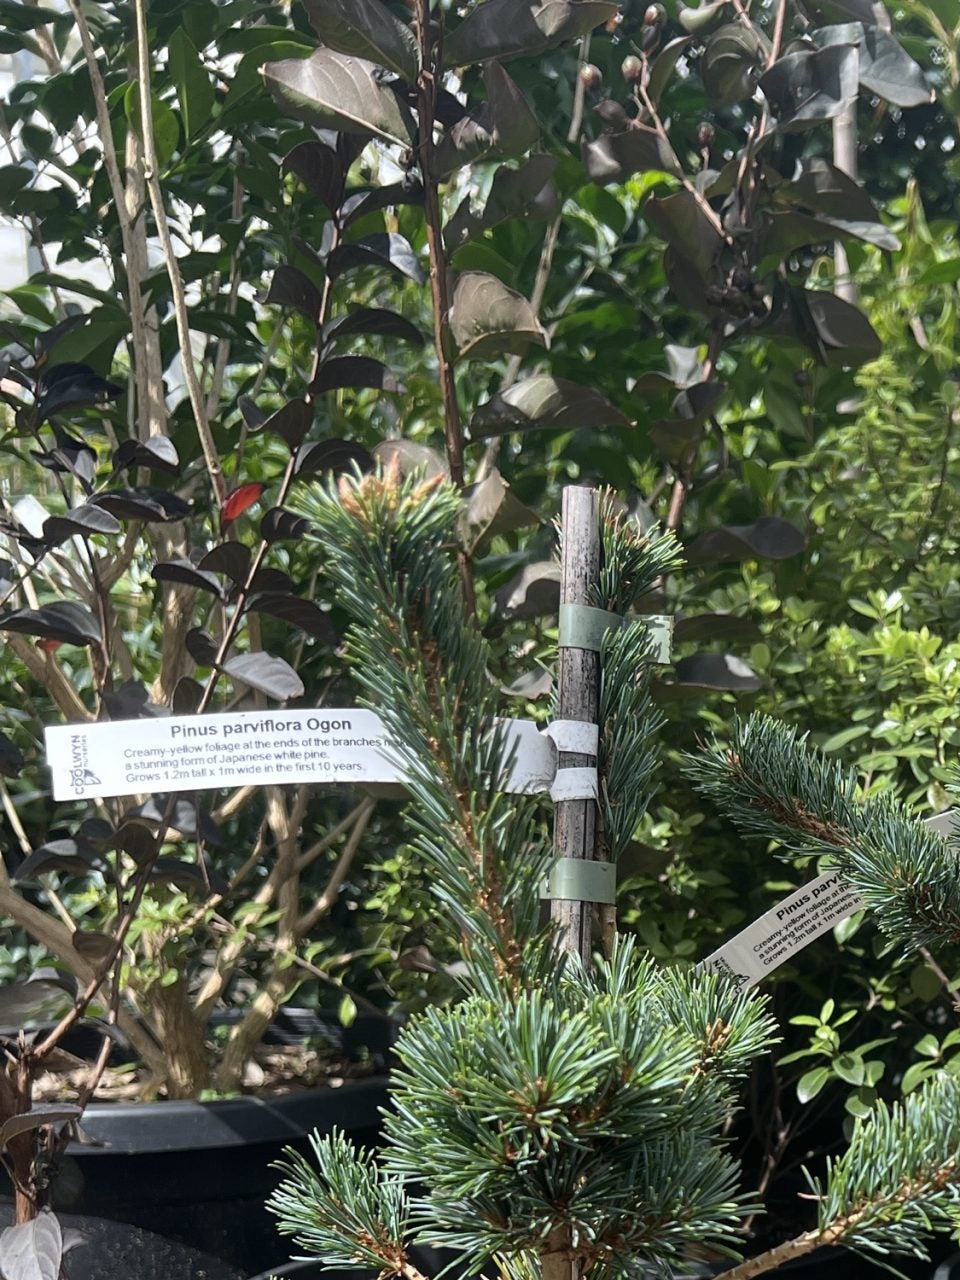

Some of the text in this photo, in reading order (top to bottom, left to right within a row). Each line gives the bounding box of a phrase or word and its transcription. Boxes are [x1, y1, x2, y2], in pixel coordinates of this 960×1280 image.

[171, 718, 352, 738] Pinus parviflora Ogon
[124, 745, 203, 758] Creamy-yellow
[205, 742, 240, 752] foliage
[243, 741, 253, 749] at
[254, 740, 271, 748] the
[273, 739, 299, 747] ends
[302, 738, 312, 746] of
[314, 738, 330, 746] the
[333, 737, 380, 746] branches
[134, 760, 179, 768] stunning
[181, 757, 205, 766] form
[207, 755, 217, 764] of
[219, 754, 272, 764] Japanese
[274, 752, 302, 760] white
[71, 735, 84, 794] COOLWYN
[126, 773, 160, 782] Grows
[164, 770, 190, 779] 1.2m
[192, 768, 207, 777] tall
[219, 767, 234, 775] 1m
[237, 765, 262, 774] wide
[264, 764, 273, 772] in
[276, 763, 293, 771] the
[295, 762, 315, 771] first
[318, 762, 330, 770] 10
[776, 894, 810, 920] Pinus
[753, 911, 806, 952] Creamy-yellow
[806, 896, 831, 915] foliage
[831, 890, 839, 898] at
[763, 947, 788, 966] Grows
[788, 933, 807, 947] 1.2m
[806, 925, 817, 935] tall
[823, 914, 836, 922] 1m
[835, 901, 854, 915] wide
[854, 896, 862, 904] in
[764, 931, 796, 955] stunning
[795, 918, 812, 933] form
[812, 911, 820, 921] of
